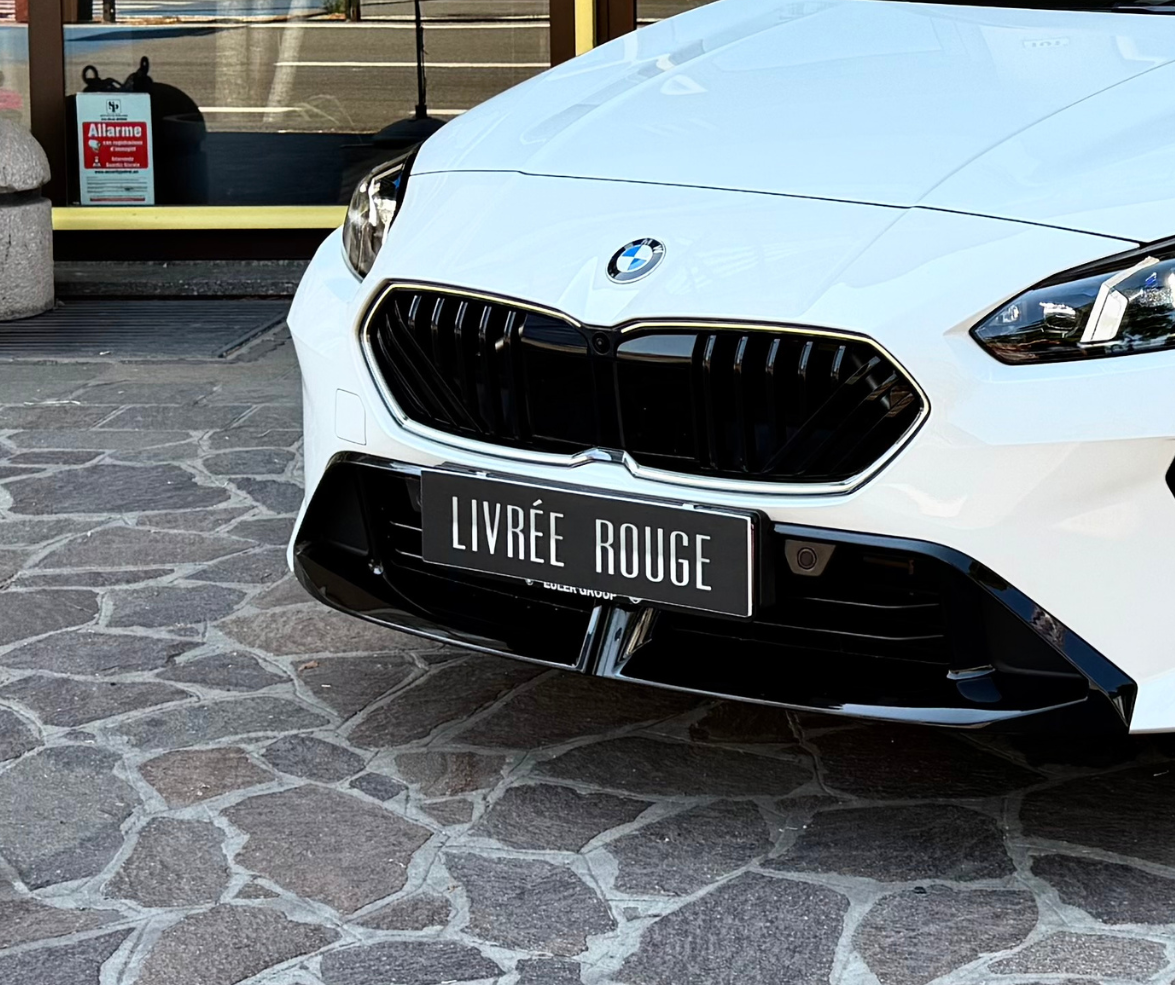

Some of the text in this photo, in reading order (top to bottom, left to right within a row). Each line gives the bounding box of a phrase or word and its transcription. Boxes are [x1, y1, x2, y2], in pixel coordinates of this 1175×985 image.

[88, 123, 142, 137] Allarme
[452, 496, 712, 591] LIVRÉE ROUGE
